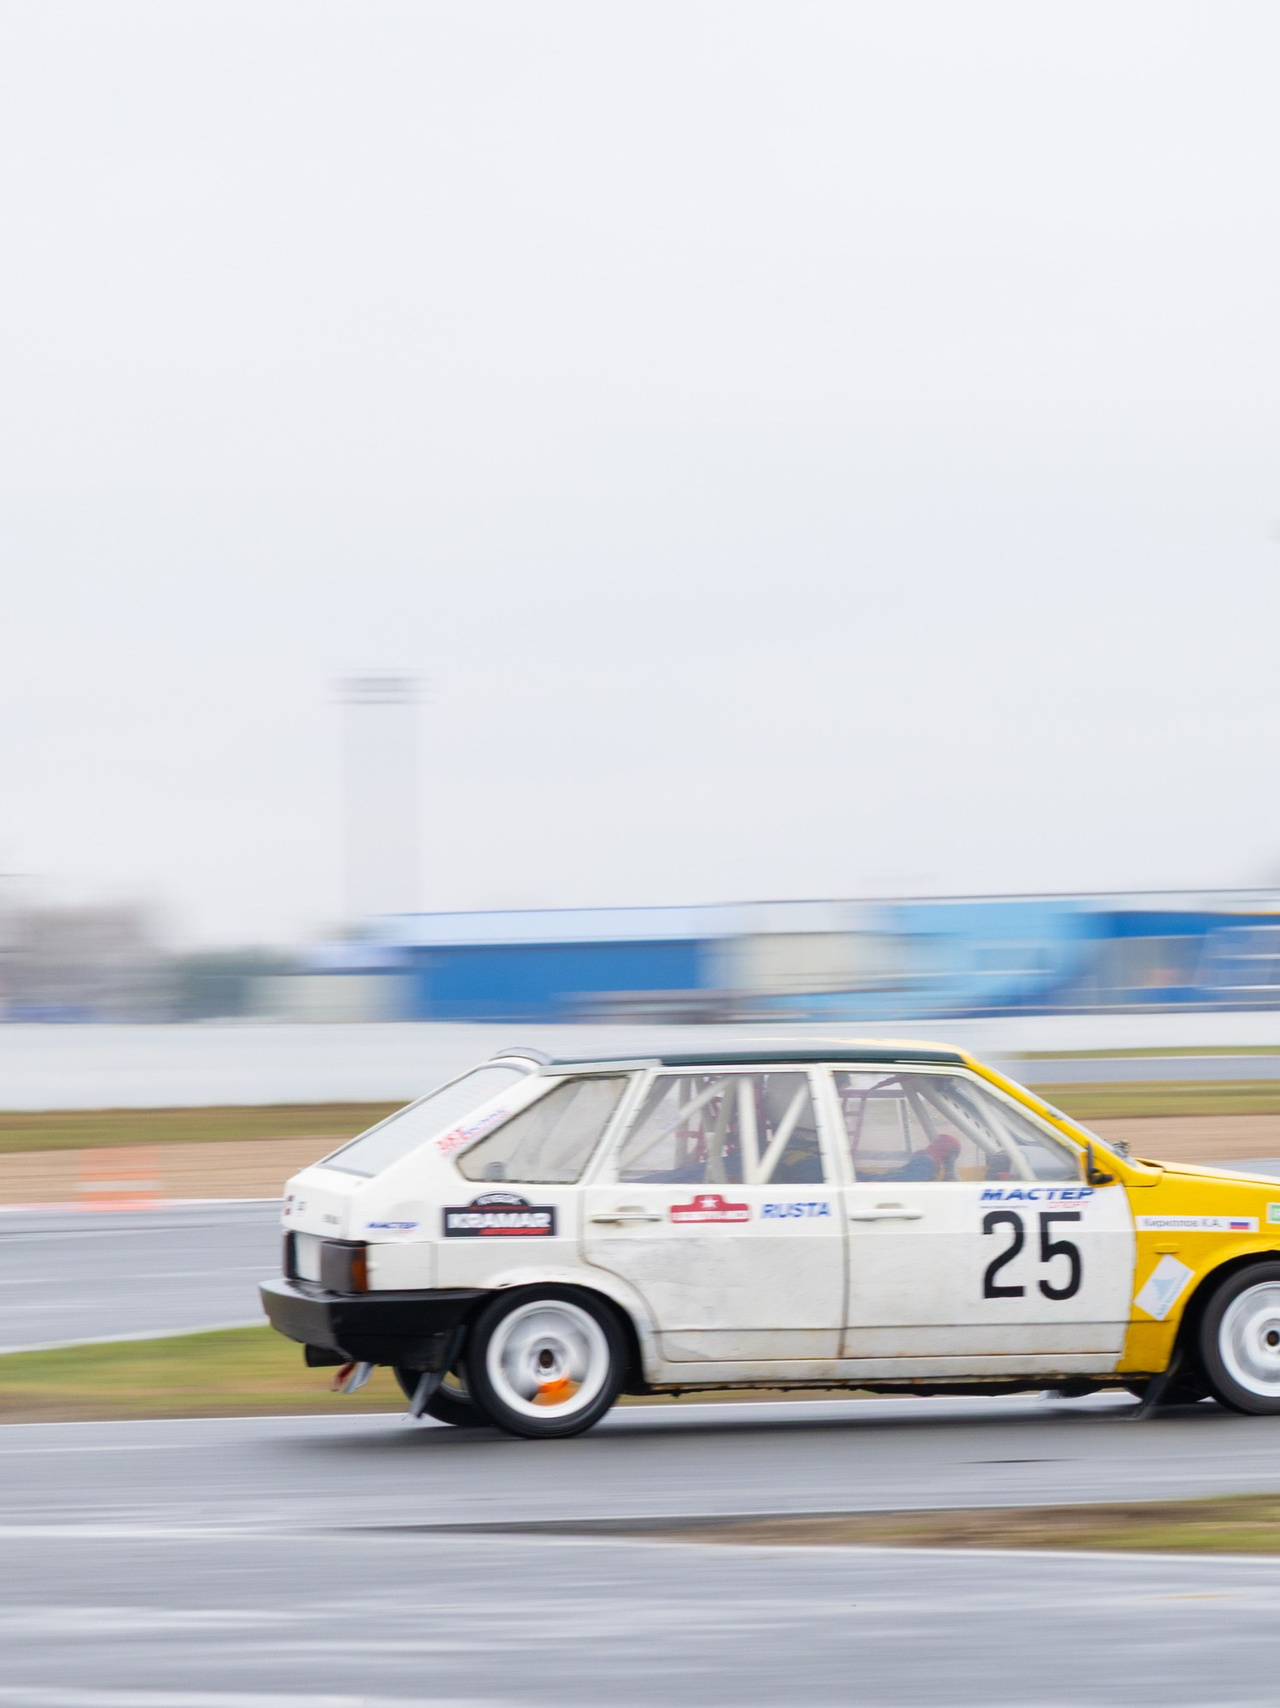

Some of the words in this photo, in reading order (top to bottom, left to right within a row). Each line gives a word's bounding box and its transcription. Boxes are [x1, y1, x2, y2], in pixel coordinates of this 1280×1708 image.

[979, 1187, 1095, 1201] МАСТЕР
[761, 1202, 832, 1219] RUSTA
[447, 1212, 551, 1228] KRAMAR
[982, 1210, 1082, 1300] 25
